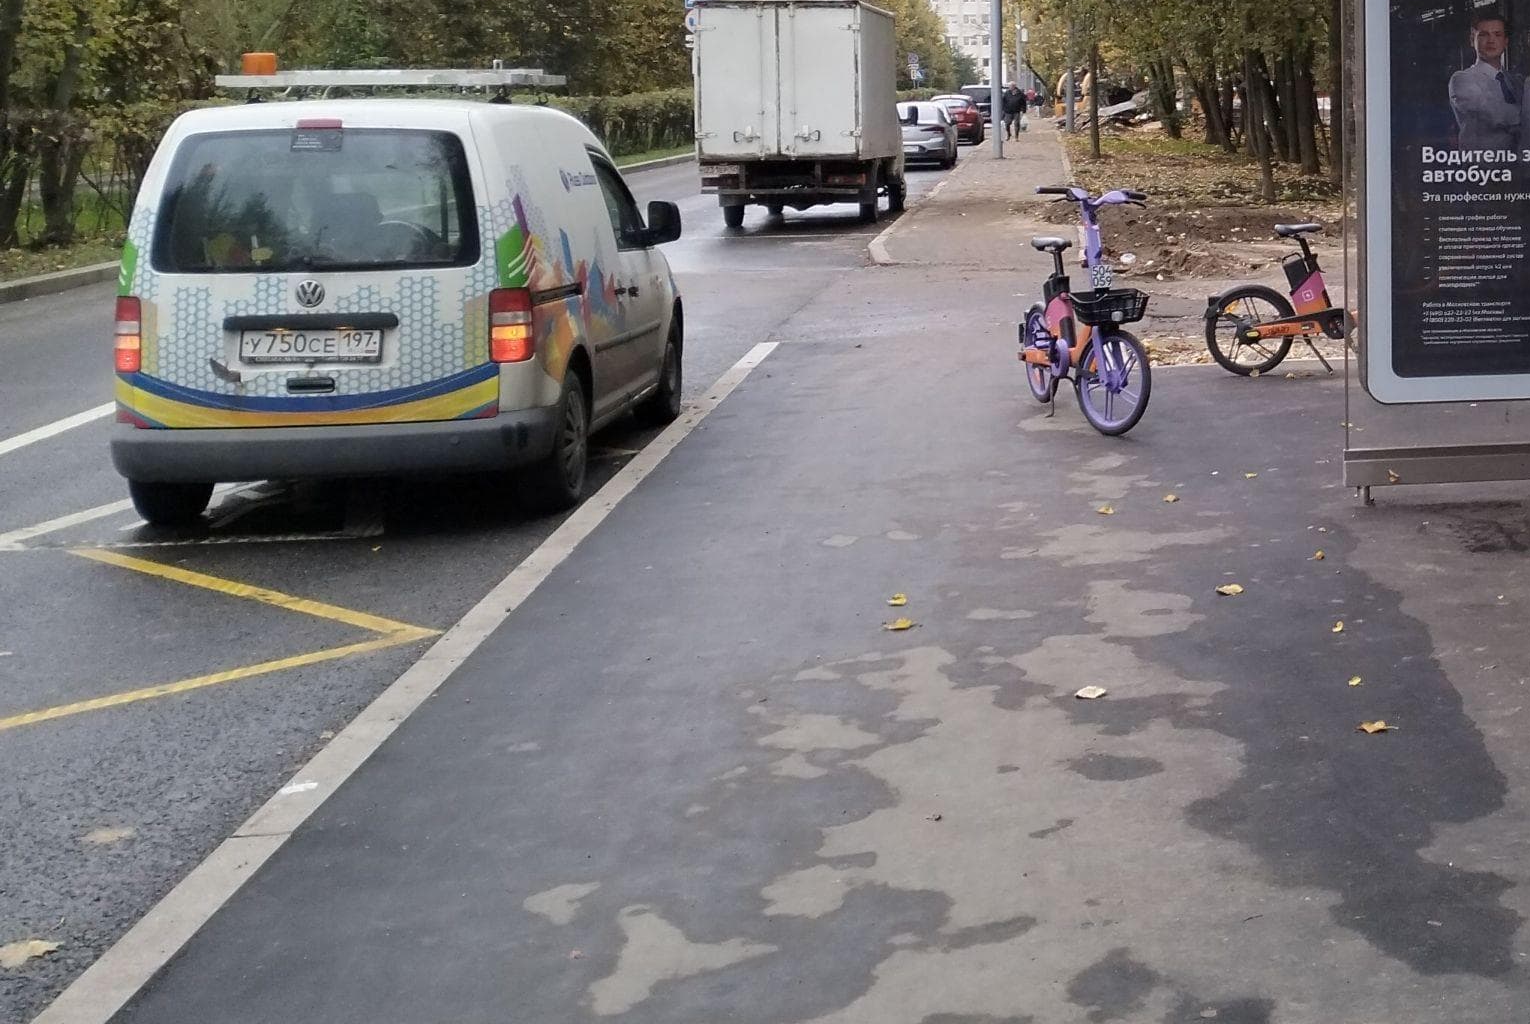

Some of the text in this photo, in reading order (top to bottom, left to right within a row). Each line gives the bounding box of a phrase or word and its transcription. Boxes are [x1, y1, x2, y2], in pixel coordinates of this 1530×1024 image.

[1421, 146, 1517, 166] Водитель
[1422, 165, 1512, 186] автобуса
[1422, 192, 1441, 202] Эта
[1443, 192, 1501, 204] профессия
[1092, 265, 1112, 276] 504
[1092, 276, 1112, 287] 059
[342, 332, 374, 348] 197
